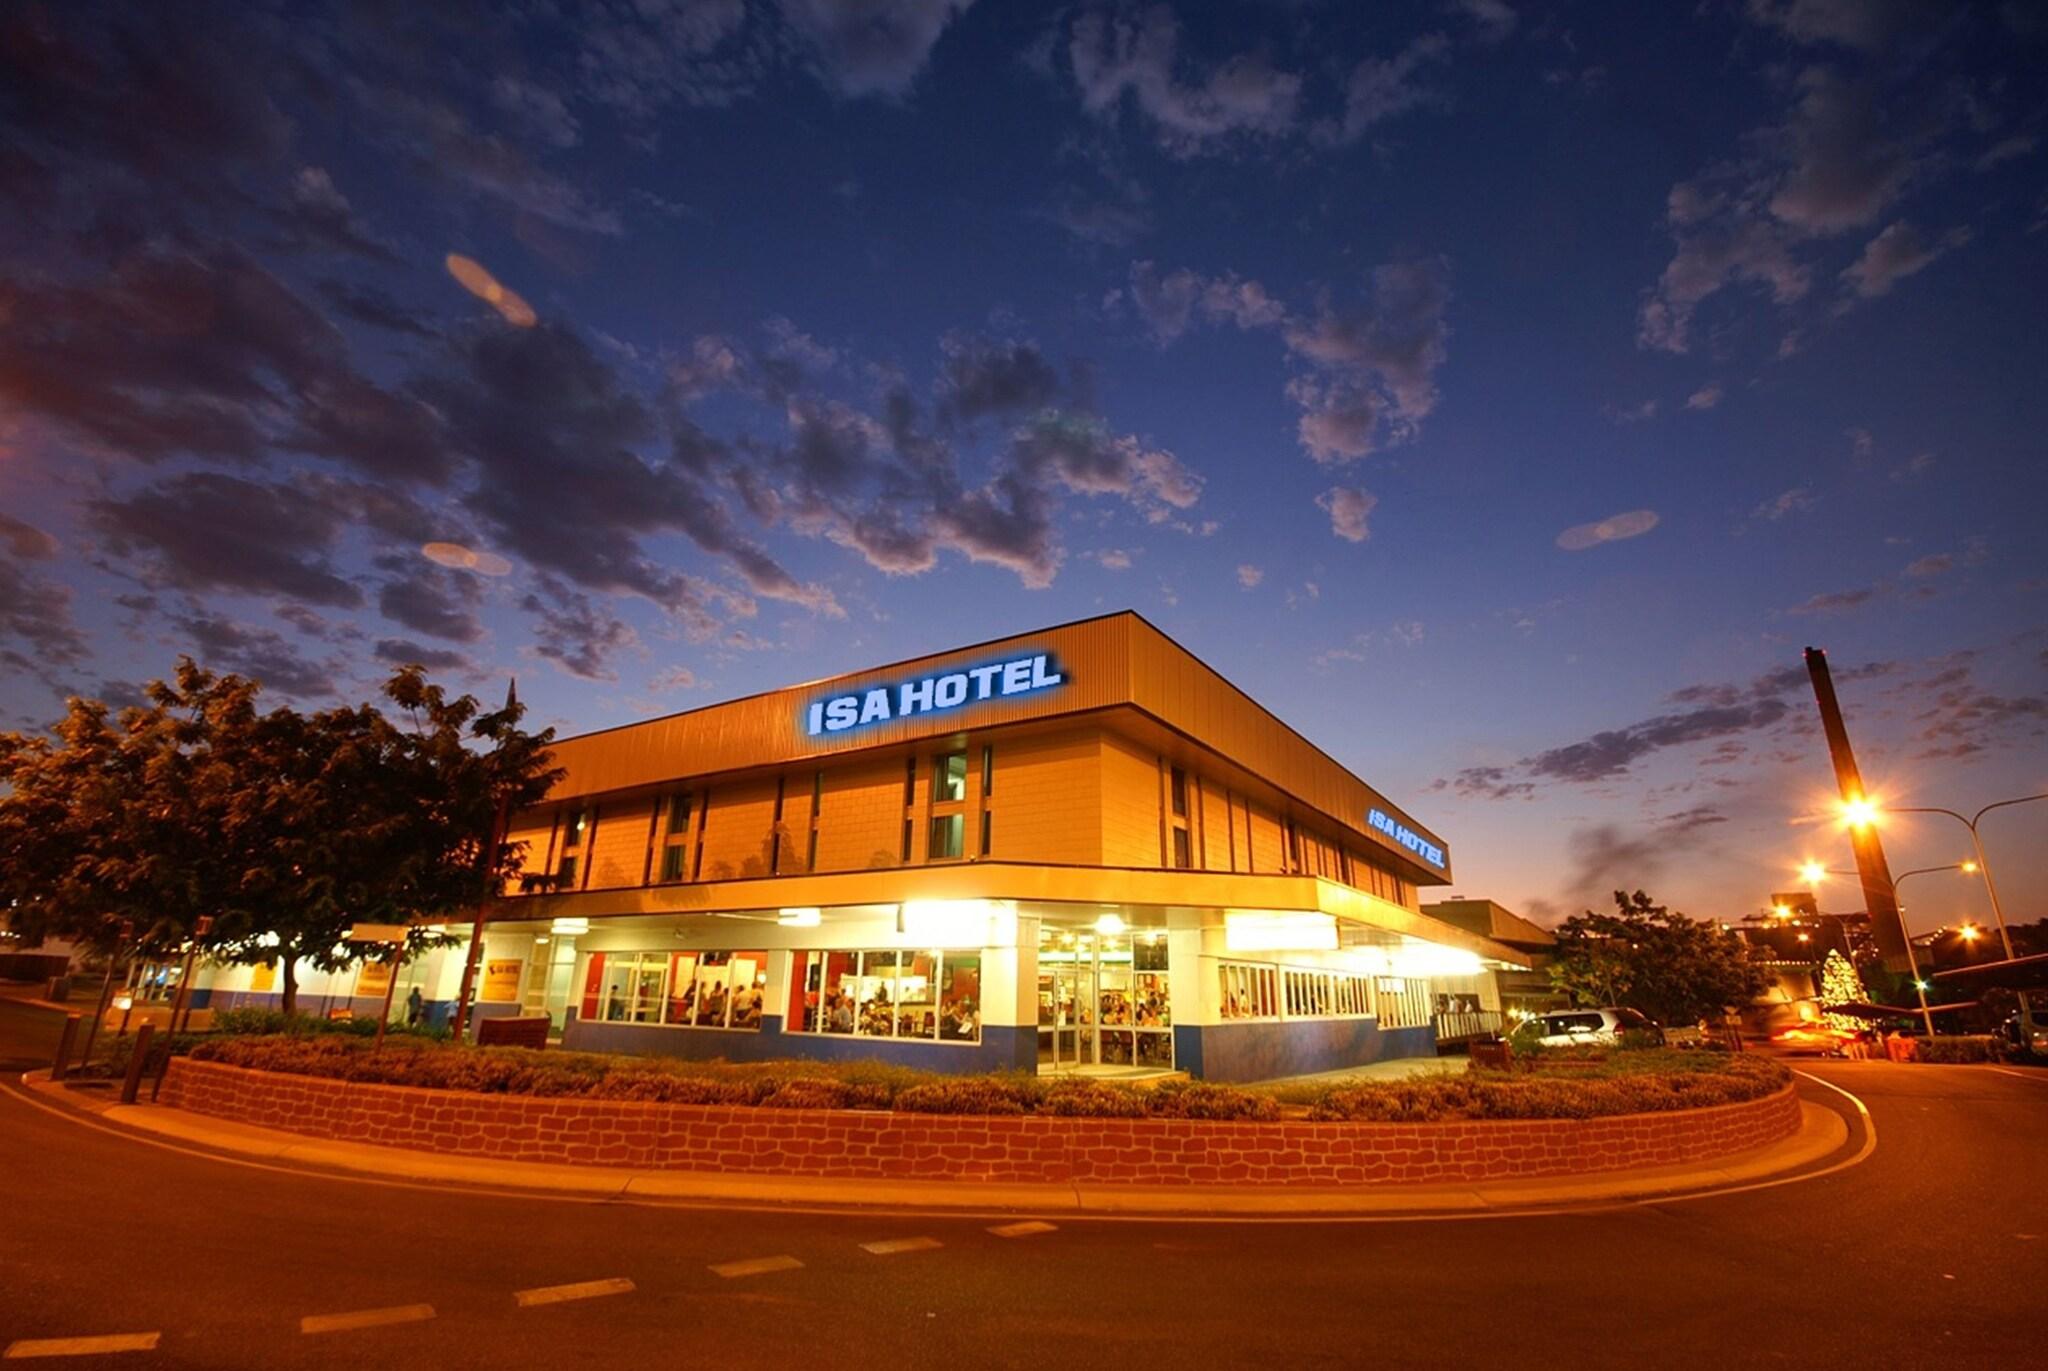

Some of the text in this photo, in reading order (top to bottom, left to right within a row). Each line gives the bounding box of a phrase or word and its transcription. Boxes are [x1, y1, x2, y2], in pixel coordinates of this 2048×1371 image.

[808, 655, 1061, 735] ISA HOTEL
[1368, 808, 1445, 869] ISA HOTEL
